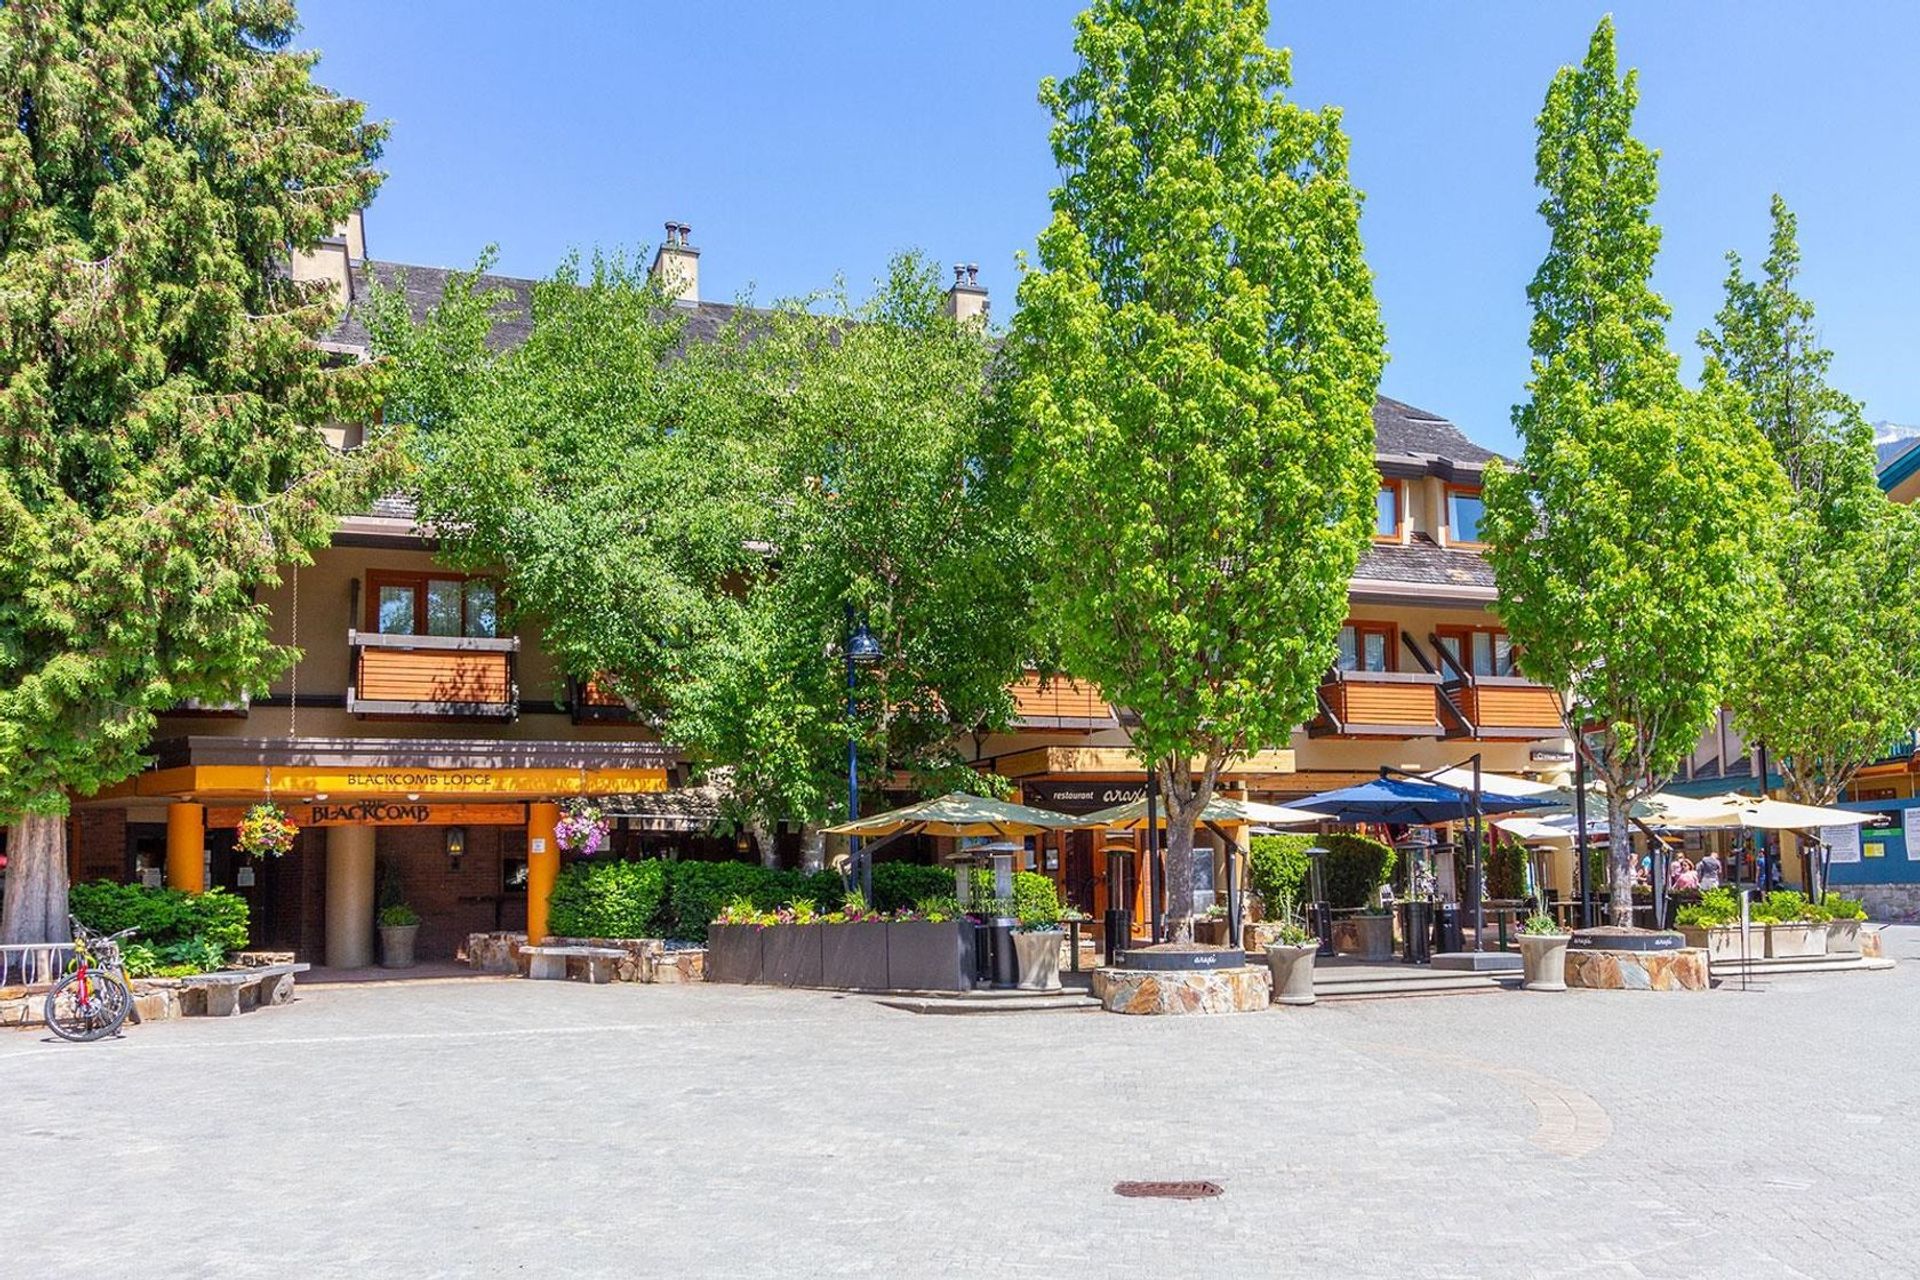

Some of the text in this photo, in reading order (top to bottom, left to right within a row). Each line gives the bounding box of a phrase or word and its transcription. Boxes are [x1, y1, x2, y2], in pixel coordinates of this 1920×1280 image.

[347, 773, 491, 785] BLACKCOMB LODGE
[1053, 783, 1149, 803] restaurant araxi
[312, 805, 430, 823] BLACKCOMB
